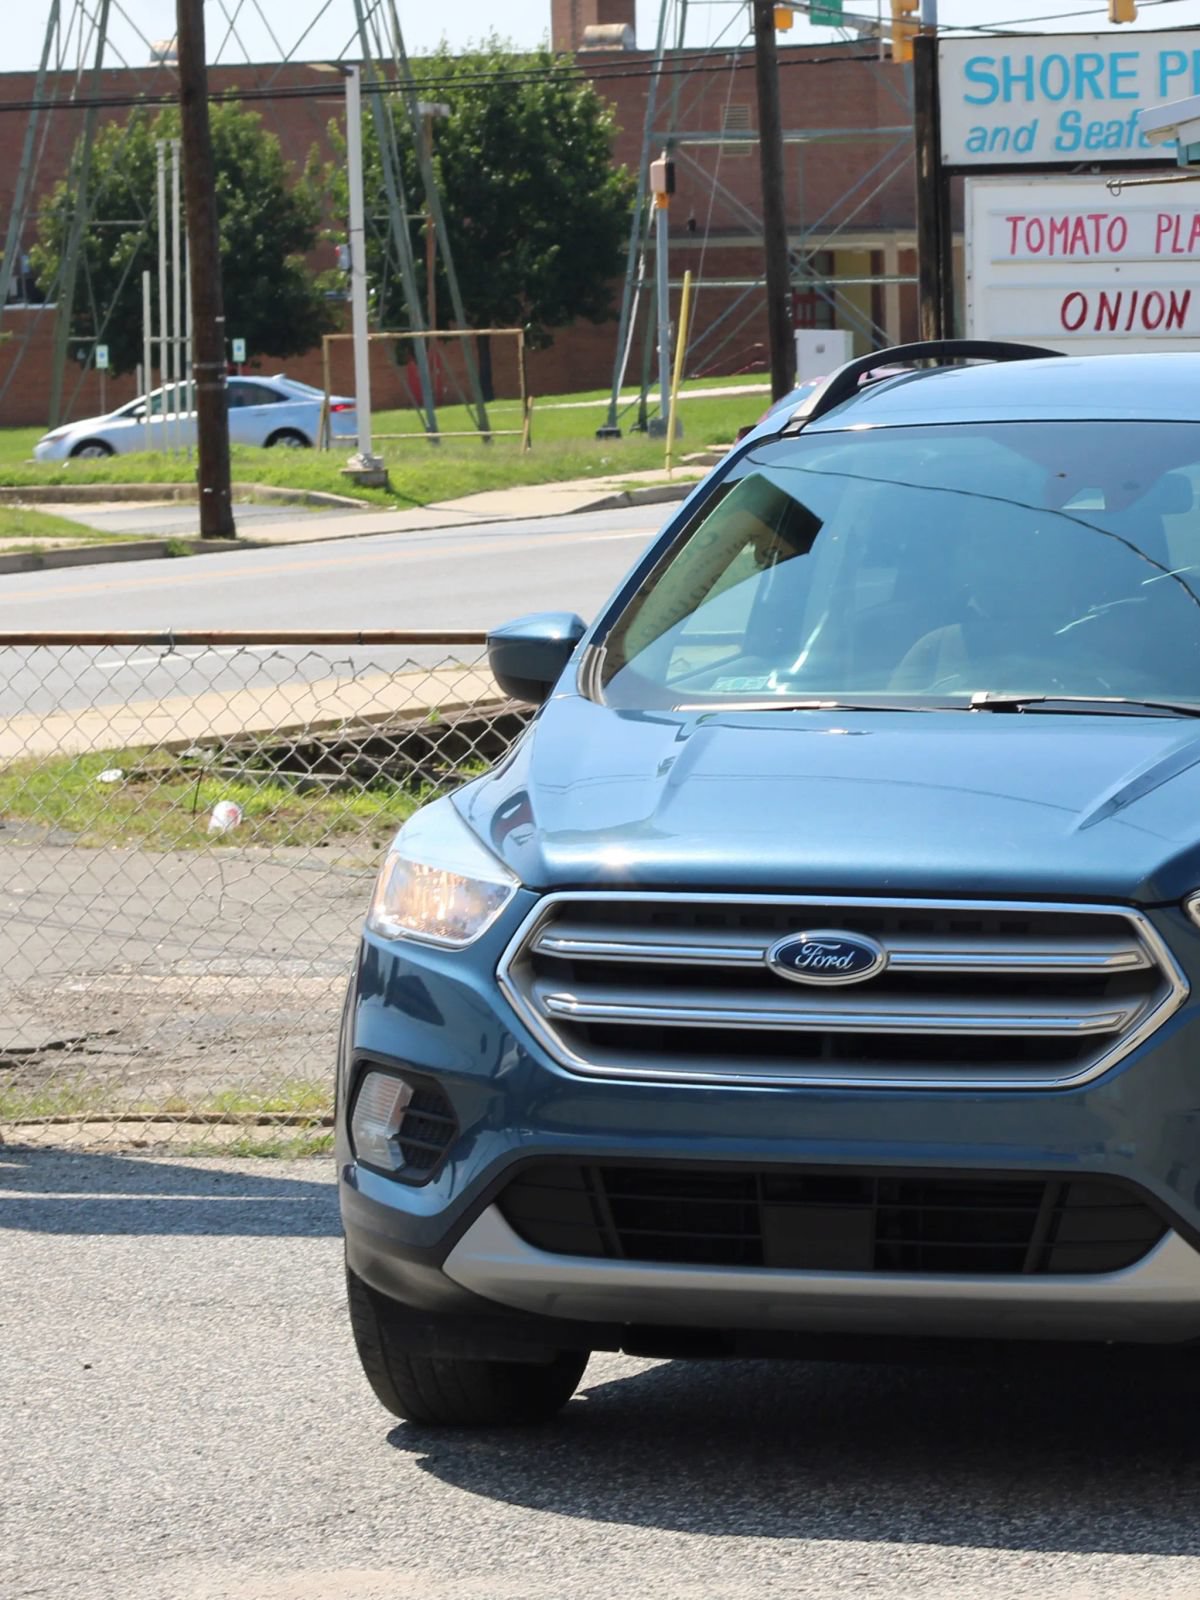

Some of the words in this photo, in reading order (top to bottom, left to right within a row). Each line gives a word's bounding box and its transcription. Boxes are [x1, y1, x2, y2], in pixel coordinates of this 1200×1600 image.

[963, 52, 1140, 106] SHORE
[965, 119, 1039, 153] and
[1006, 213, 1128, 256] TOMATO
[794, 941, 855, 971] Ford
